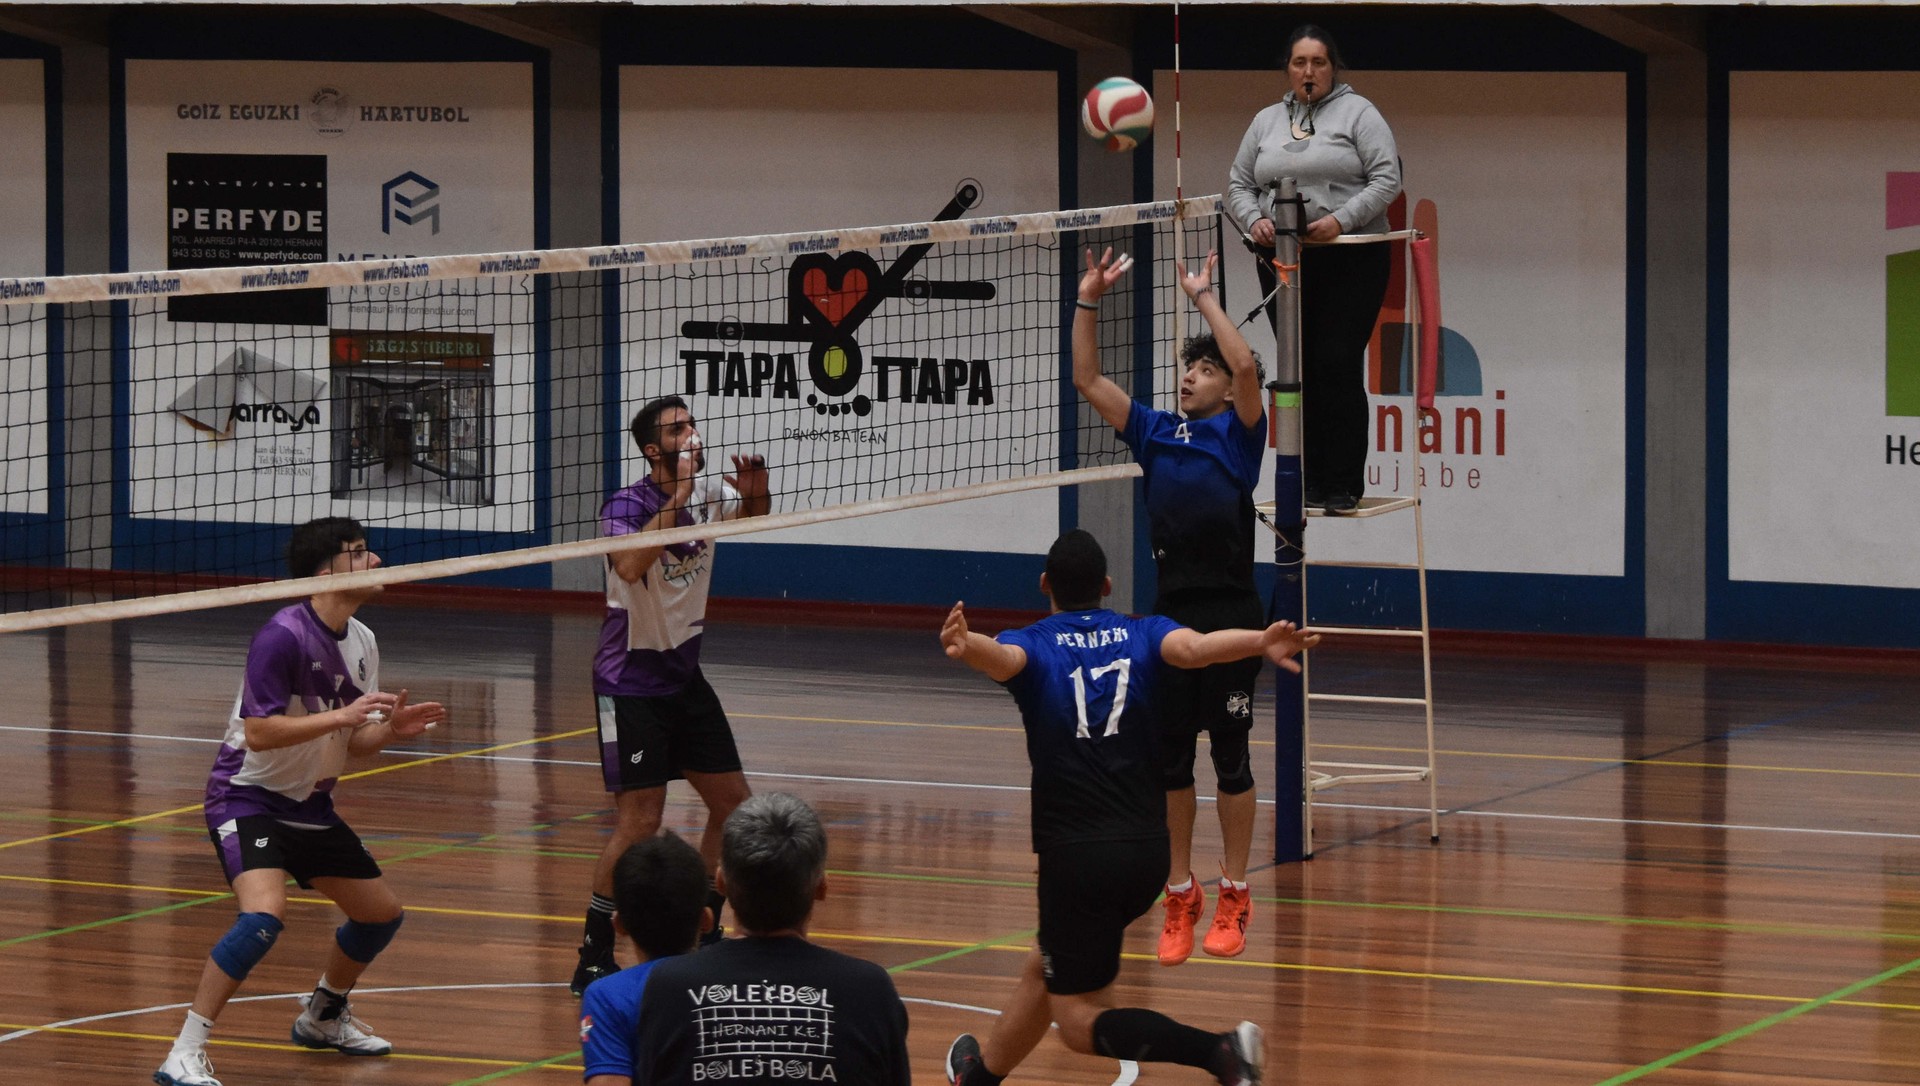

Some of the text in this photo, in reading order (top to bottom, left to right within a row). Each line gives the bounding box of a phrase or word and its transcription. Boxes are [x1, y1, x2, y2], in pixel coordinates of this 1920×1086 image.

[360, 105, 470, 123] HARTUBOL
[172, 208, 323, 232] PERFYDE
[108, 275, 181, 295] www.rfevb.com
[241, 268, 309, 288] www.rfevb.com
[363, 261, 429, 282] www.rfevb.com
[479, 255, 541, 273] www.rfevb.com
[588, 248, 646, 267] www.rfevb.com
[691, 242, 747, 260] www.rfevb.com
[788, 235, 840, 253] www.rfevb.com
[880, 226, 929, 244] www.rfevb.com
[969, 219, 1018, 236] www.rfevb.com
[1055, 212, 1101, 229] www.rfevb.com
[1136, 203, 1176, 221] www.rfevb.co
[193, 236, 236, 246] AKARREGI
[259, 237, 283, 247] 20120
[285, 238, 323, 247] HERNANI
[172, 248, 323, 262] 943 33 63 63 www.perfyde.com
[340, 286, 480, 296] INMOBLIARIA
[679, 350, 994, 405] TTAPA TTAPA
[783, 427, 887, 445] DENOK BATEAN
[1174, 422, 1192, 443] 4
[1368, 460, 1481, 492] ujabe
[1068, 658, 1131, 739] 17
[712, 1023, 789, 1038] HERNANI
